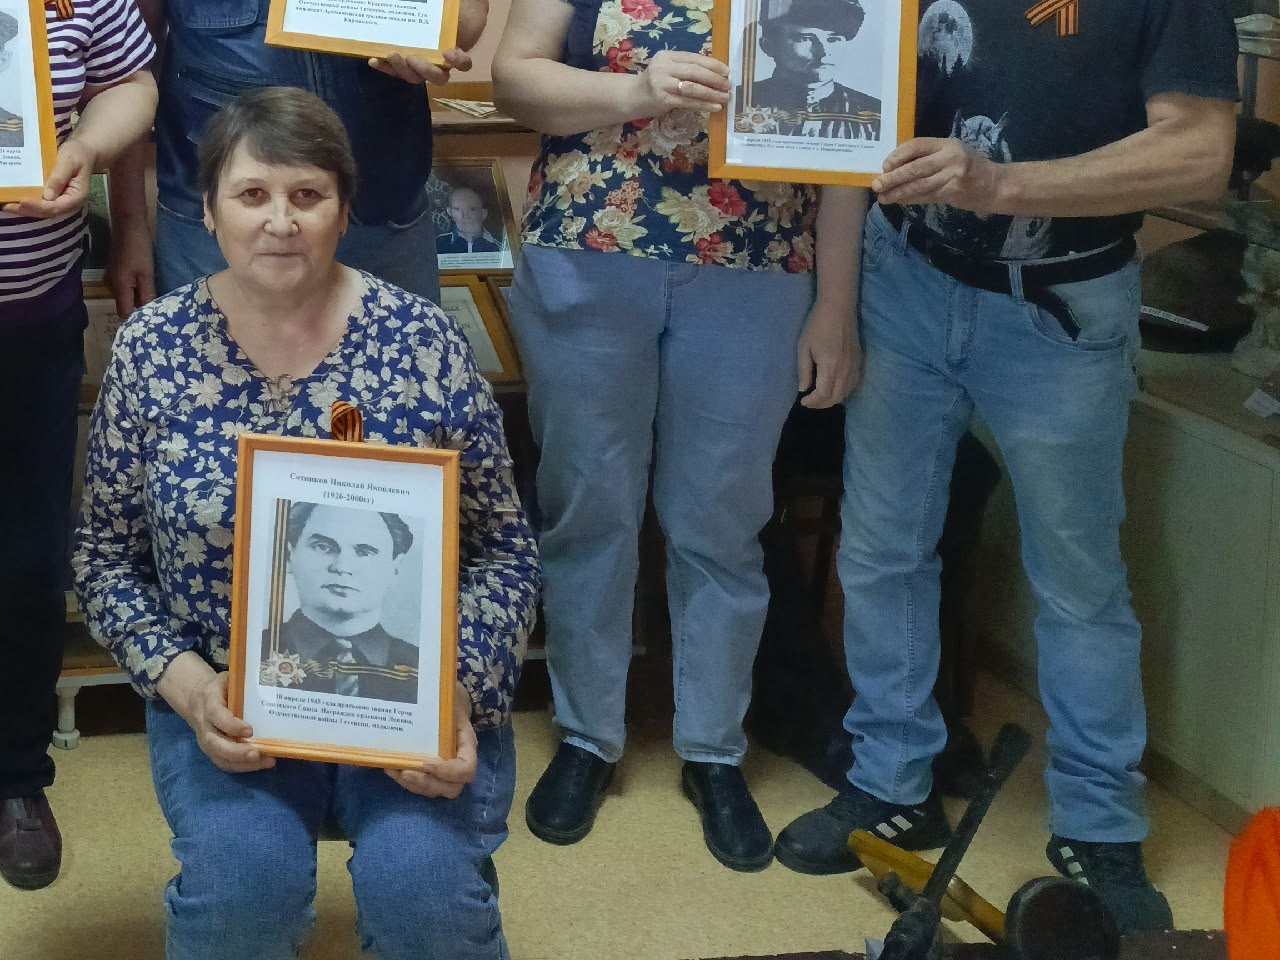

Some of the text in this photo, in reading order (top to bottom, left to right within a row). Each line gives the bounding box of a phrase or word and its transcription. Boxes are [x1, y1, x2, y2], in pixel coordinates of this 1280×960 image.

[289, 472, 410, 495] Сотников Николай Яковлевич
